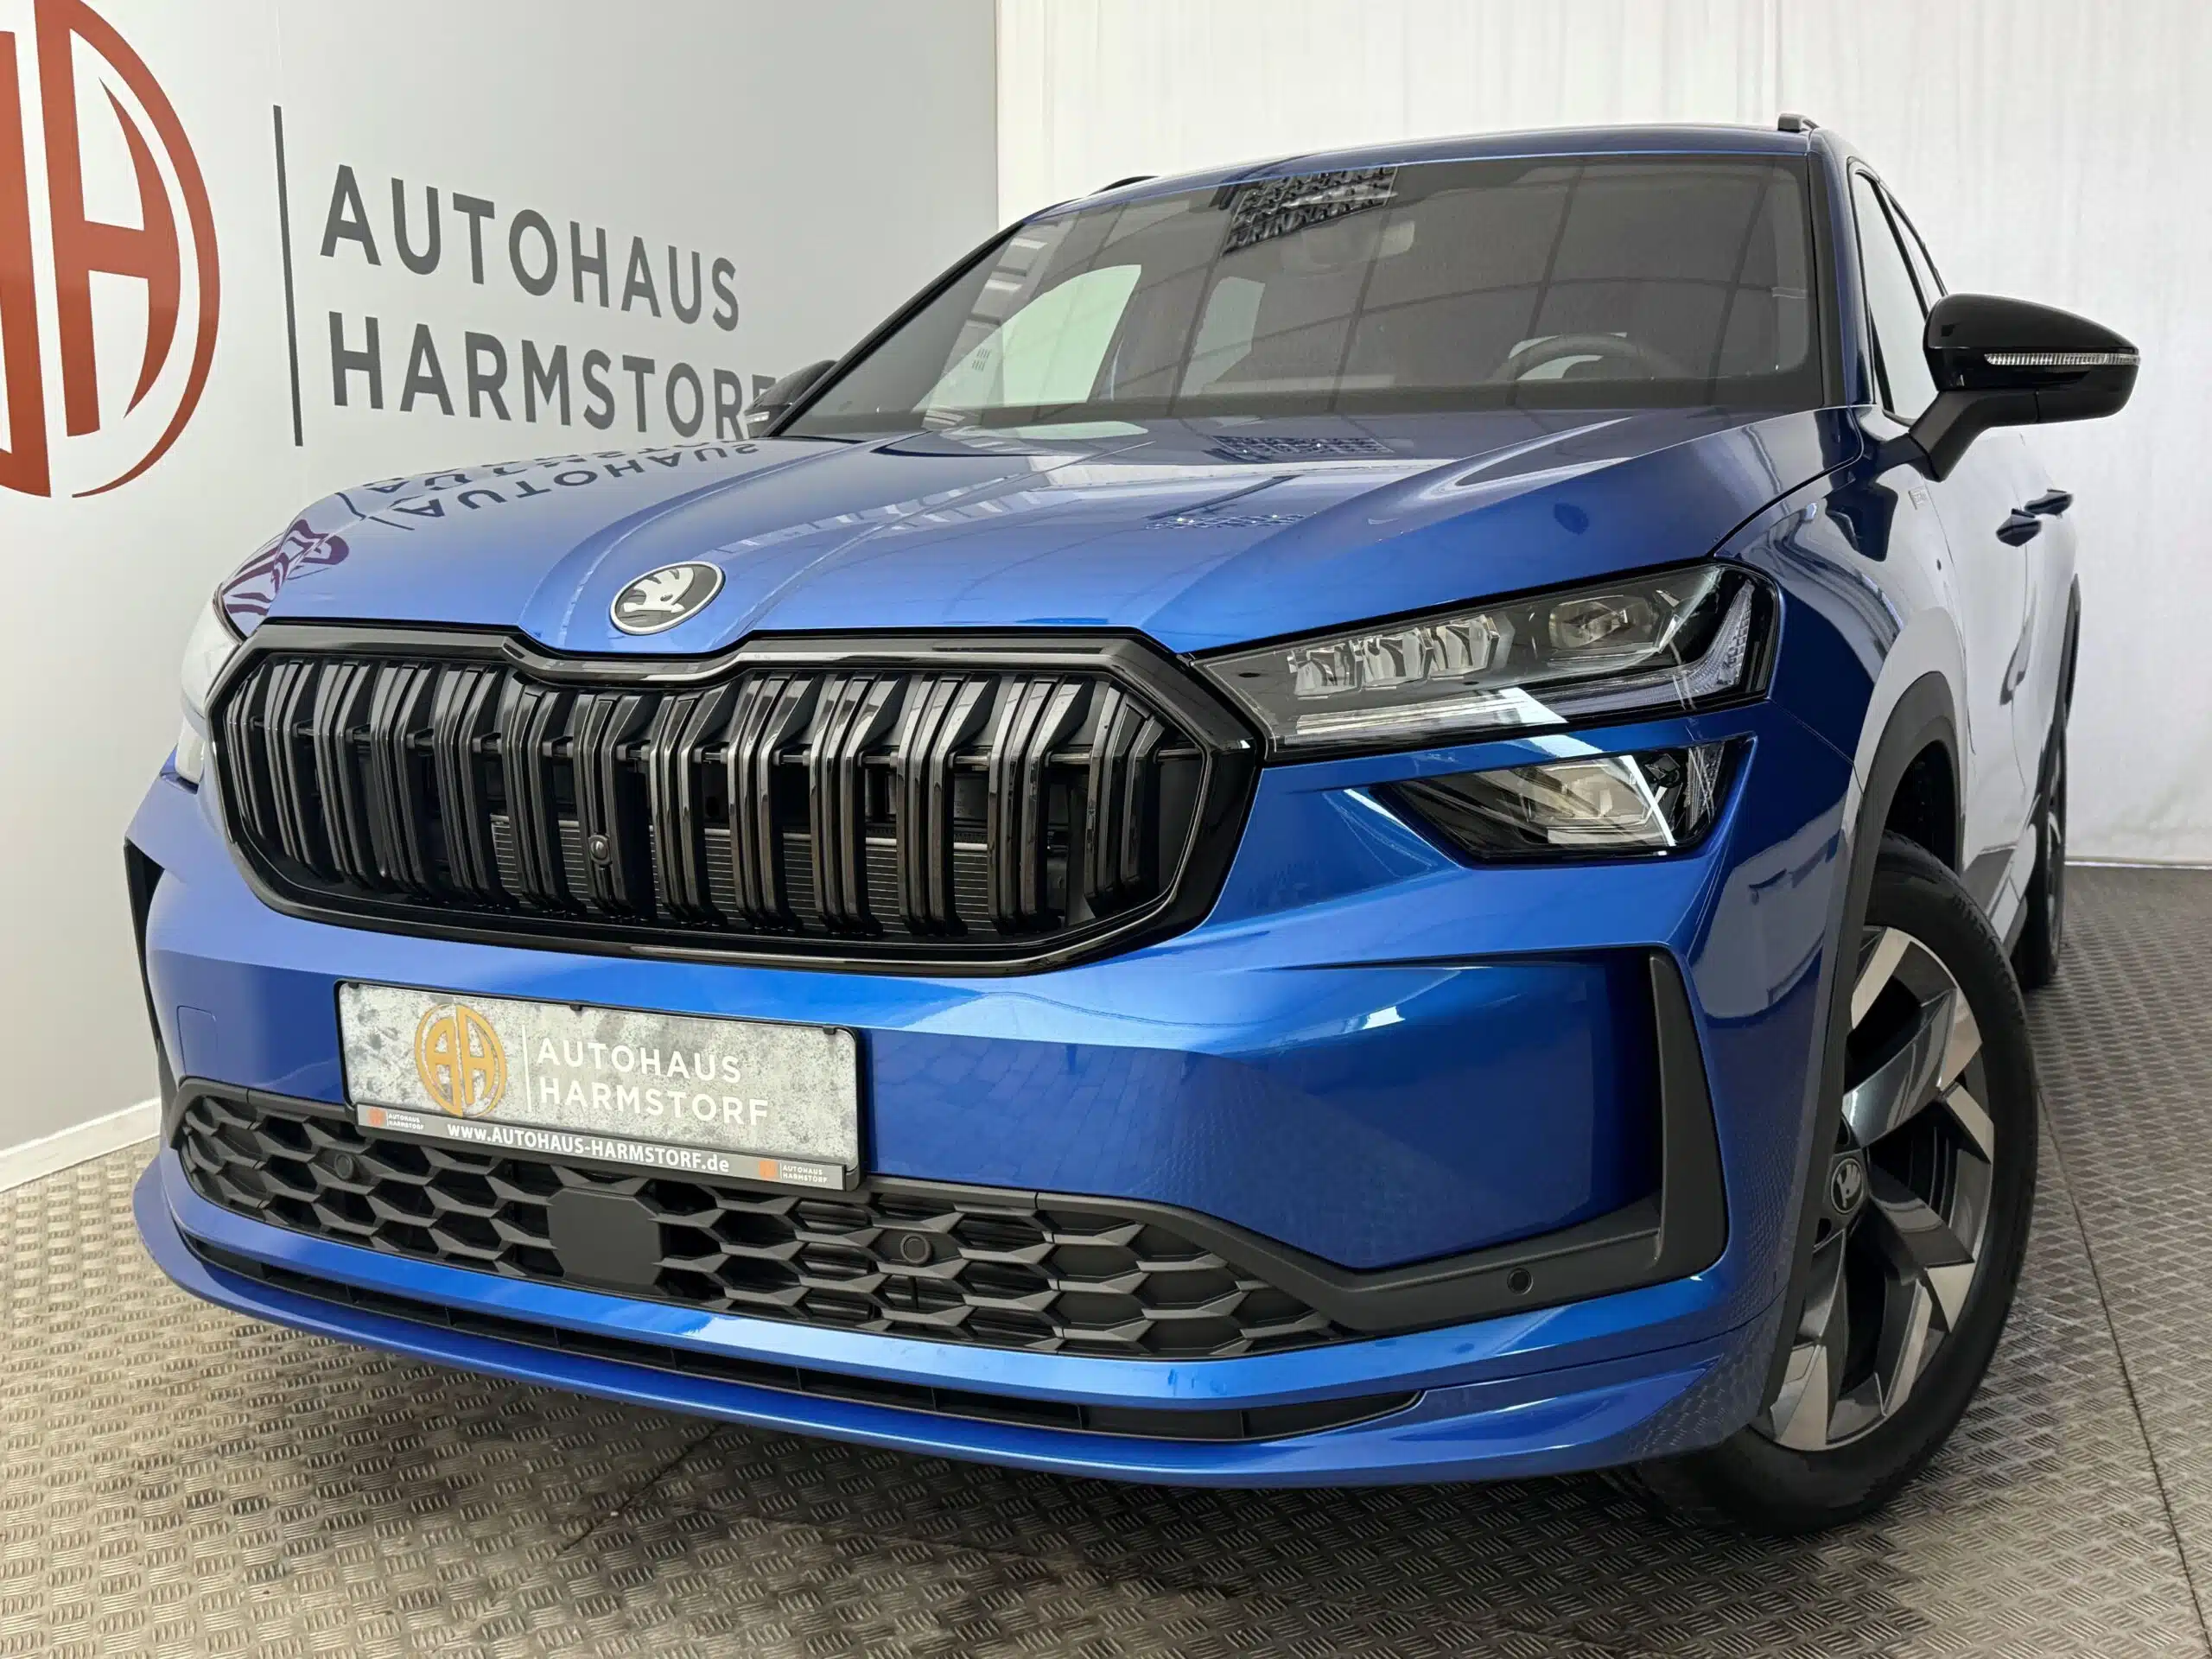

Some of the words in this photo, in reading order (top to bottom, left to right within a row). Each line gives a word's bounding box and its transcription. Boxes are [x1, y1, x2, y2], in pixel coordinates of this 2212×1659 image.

[321, 164, 740, 332] AUTOHAUS
[537, 1037, 742, 1084] AUTOHAUS
[539, 1077, 769, 1125] HARMSTORF
[447, 1124, 729, 1173] www.AUTOHAUS-HARMSTORF.de
[782, 1165, 823, 1176] AUTOHAUS
[783, 1173, 829, 1184] HARMSTORF
